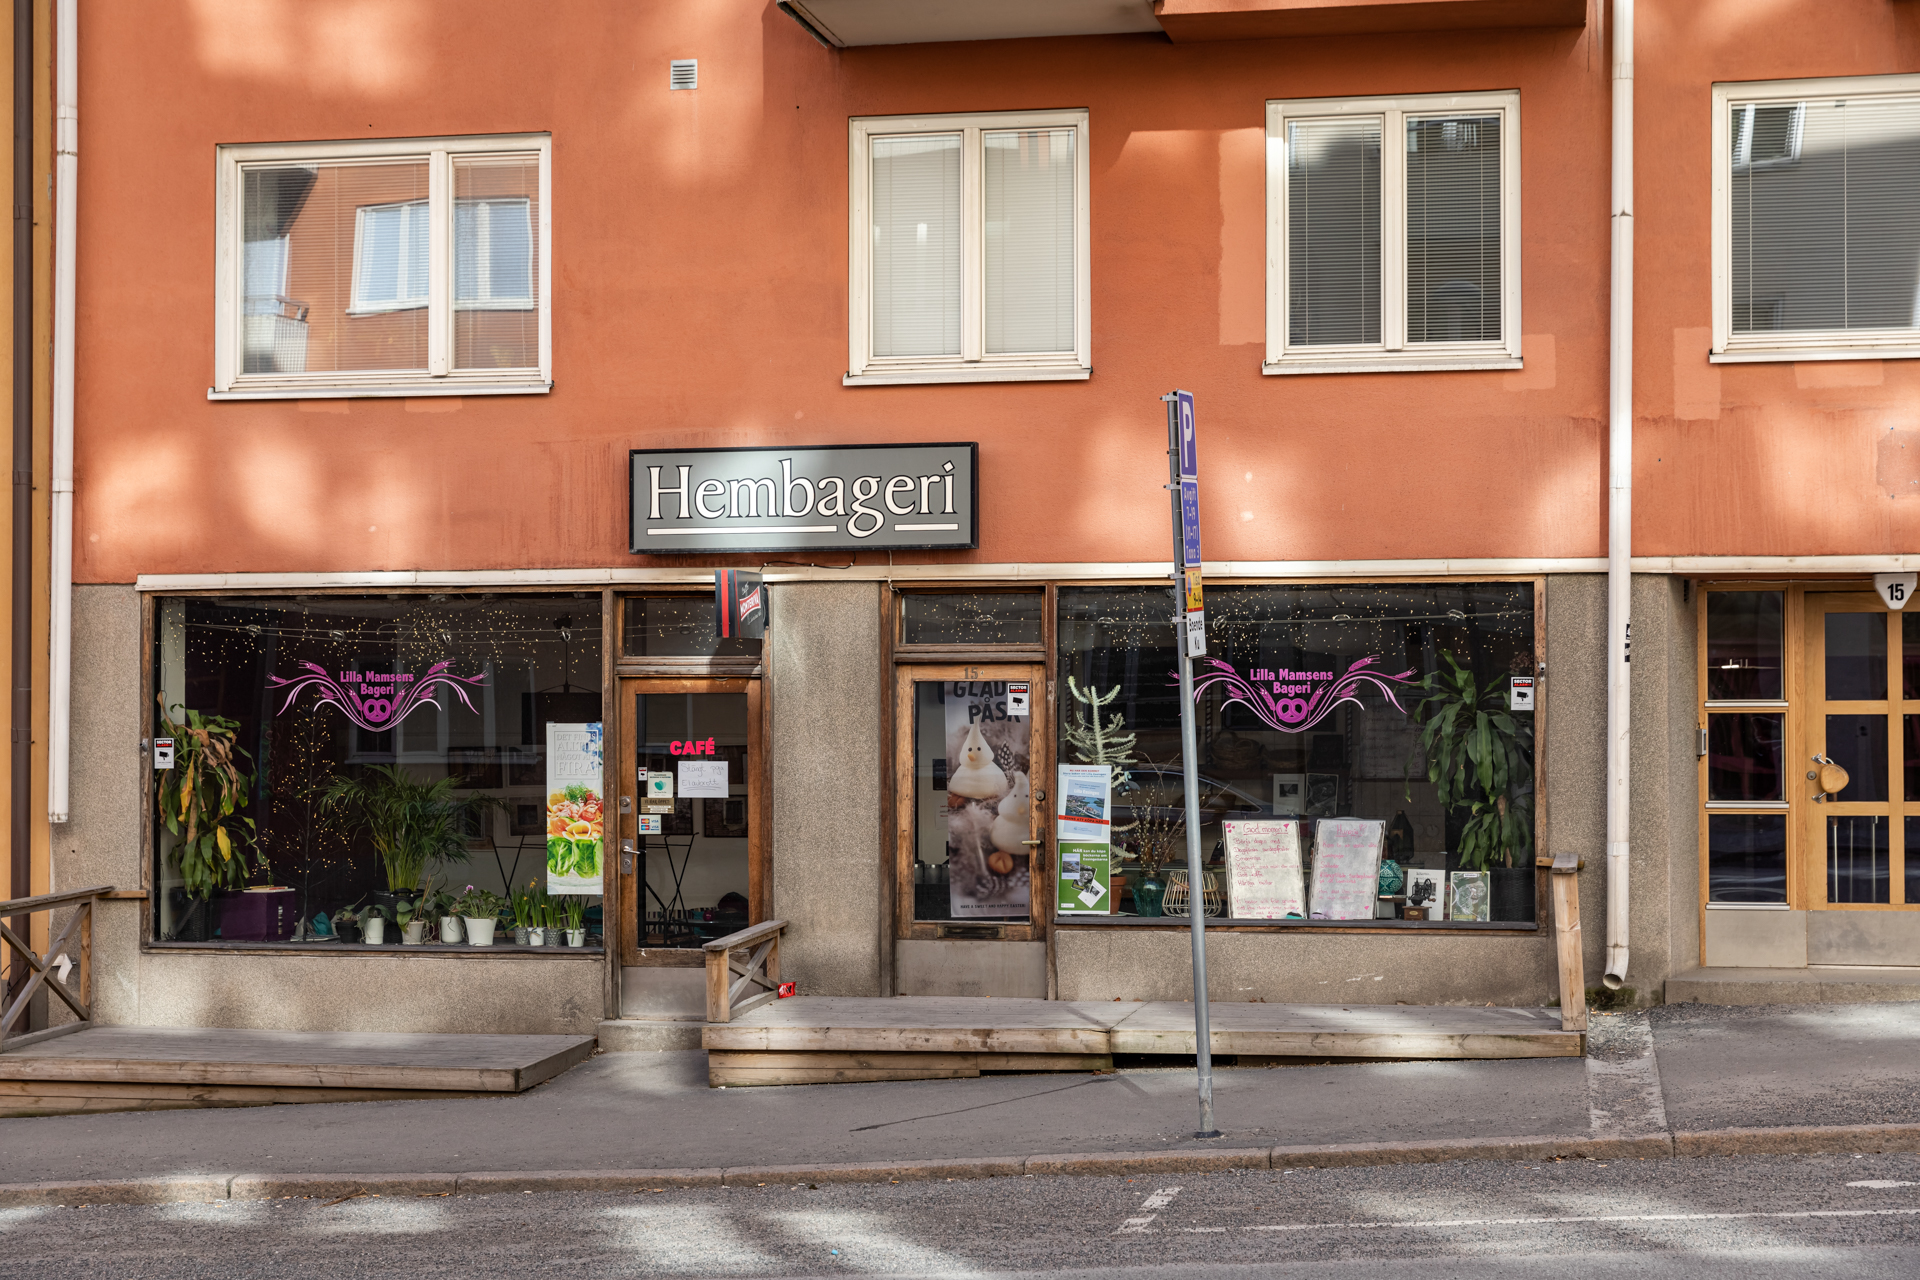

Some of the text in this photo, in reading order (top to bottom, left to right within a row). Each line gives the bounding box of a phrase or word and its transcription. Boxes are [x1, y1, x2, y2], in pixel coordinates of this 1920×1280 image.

[1182, 401, 1193, 468] P
[647, 458, 958, 538] Hembageri
[1184, 487, 1197, 504] Avgift
[1186, 545, 1200, 560] Taxa 3
[1887, 583, 1905, 602] 15
[1189, 617, 1203, 632] Boende
[340, 671, 414, 683] Lilla Mamsens
[964, 667, 978, 680] 15
[1250, 669, 1333, 681] Lilla Mamsens
[361, 684, 394, 698] Bageri
[953, 681, 1007, 699] GLAD
[1273, 682, 1311, 697] Bageri
[556, 733, 571, 741] DET
[670, 737, 715, 755] CAFÉ
[556, 760, 597, 776] FIRA
[680, 763, 724, 777] Stängt pga
[1243, 823, 1260, 833] God
